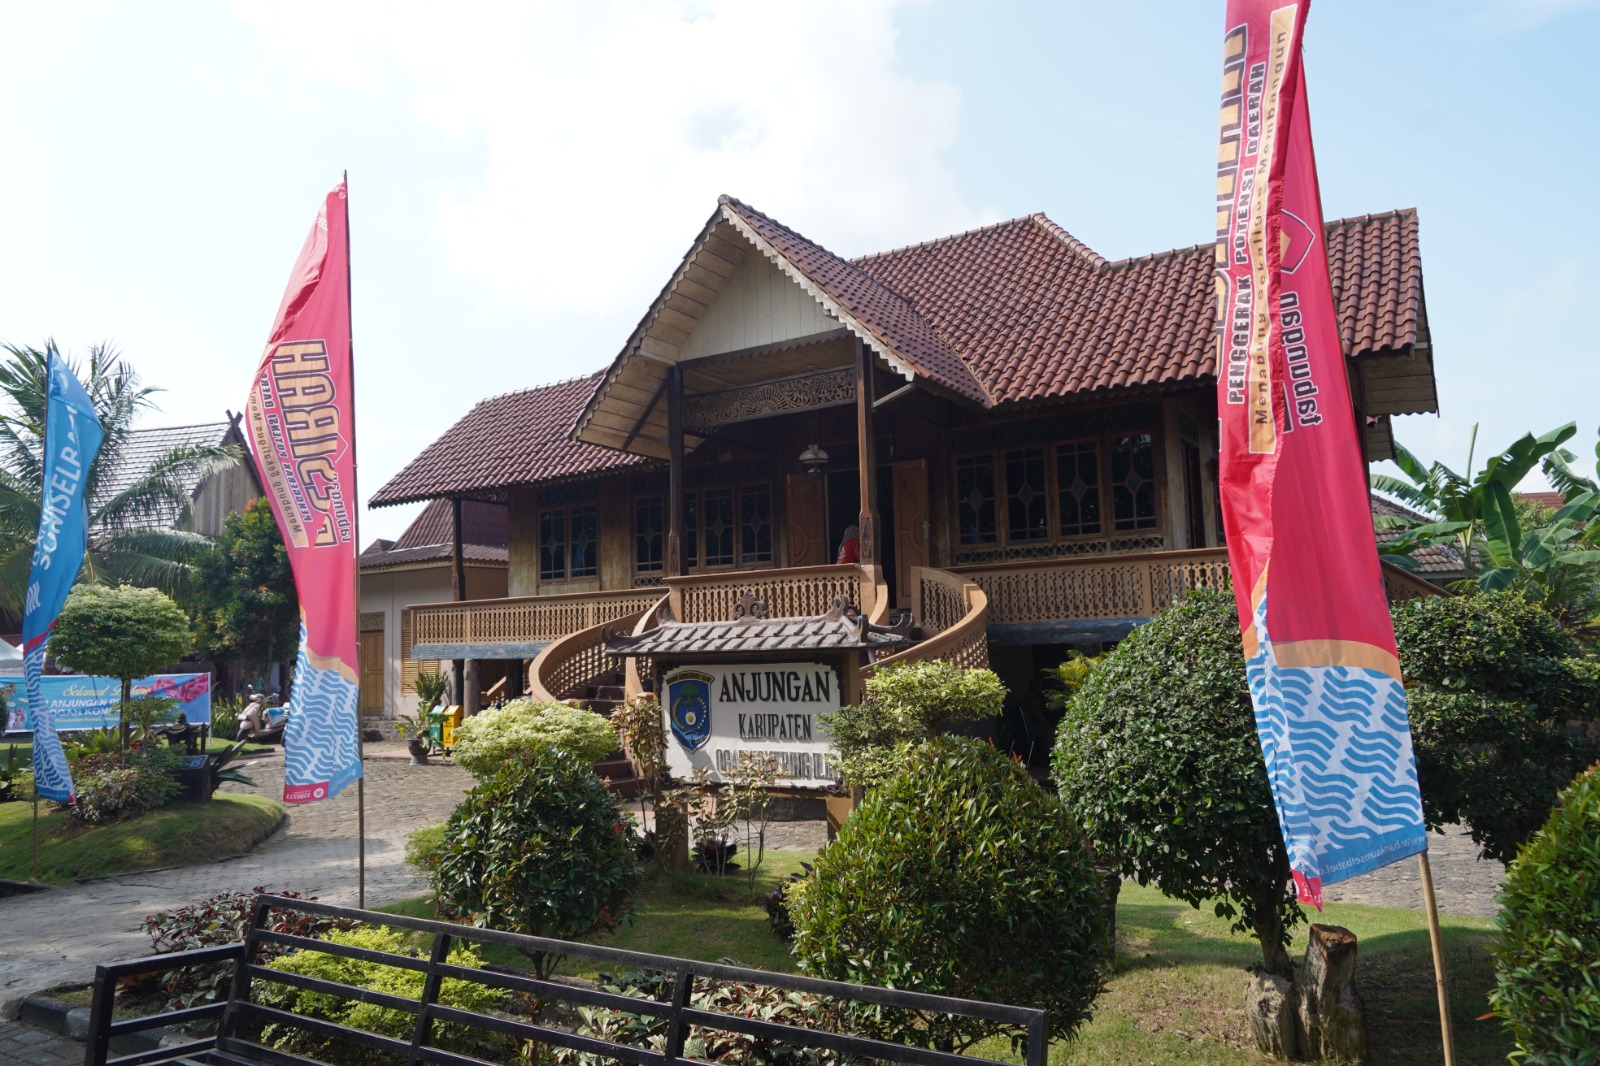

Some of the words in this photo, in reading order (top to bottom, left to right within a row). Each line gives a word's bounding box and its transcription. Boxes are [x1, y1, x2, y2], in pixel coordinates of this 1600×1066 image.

[1246, 61, 1266, 156] DAERAH
[1257, 31, 1287, 174] Membangun
[1234, 167, 1255, 264] POTENSI
[1228, 275, 1252, 404] PENGGERAK
[1256, 313, 1268, 424] Menabung
[49, 708, 82, 717] OGAN
[51, 699, 107, 708] ANJUNGAN
[63, 684, 110, 697] Selamat
[719, 671, 830, 703] ANJUNGAN
[738, 713, 812, 740] KABUPATEN
